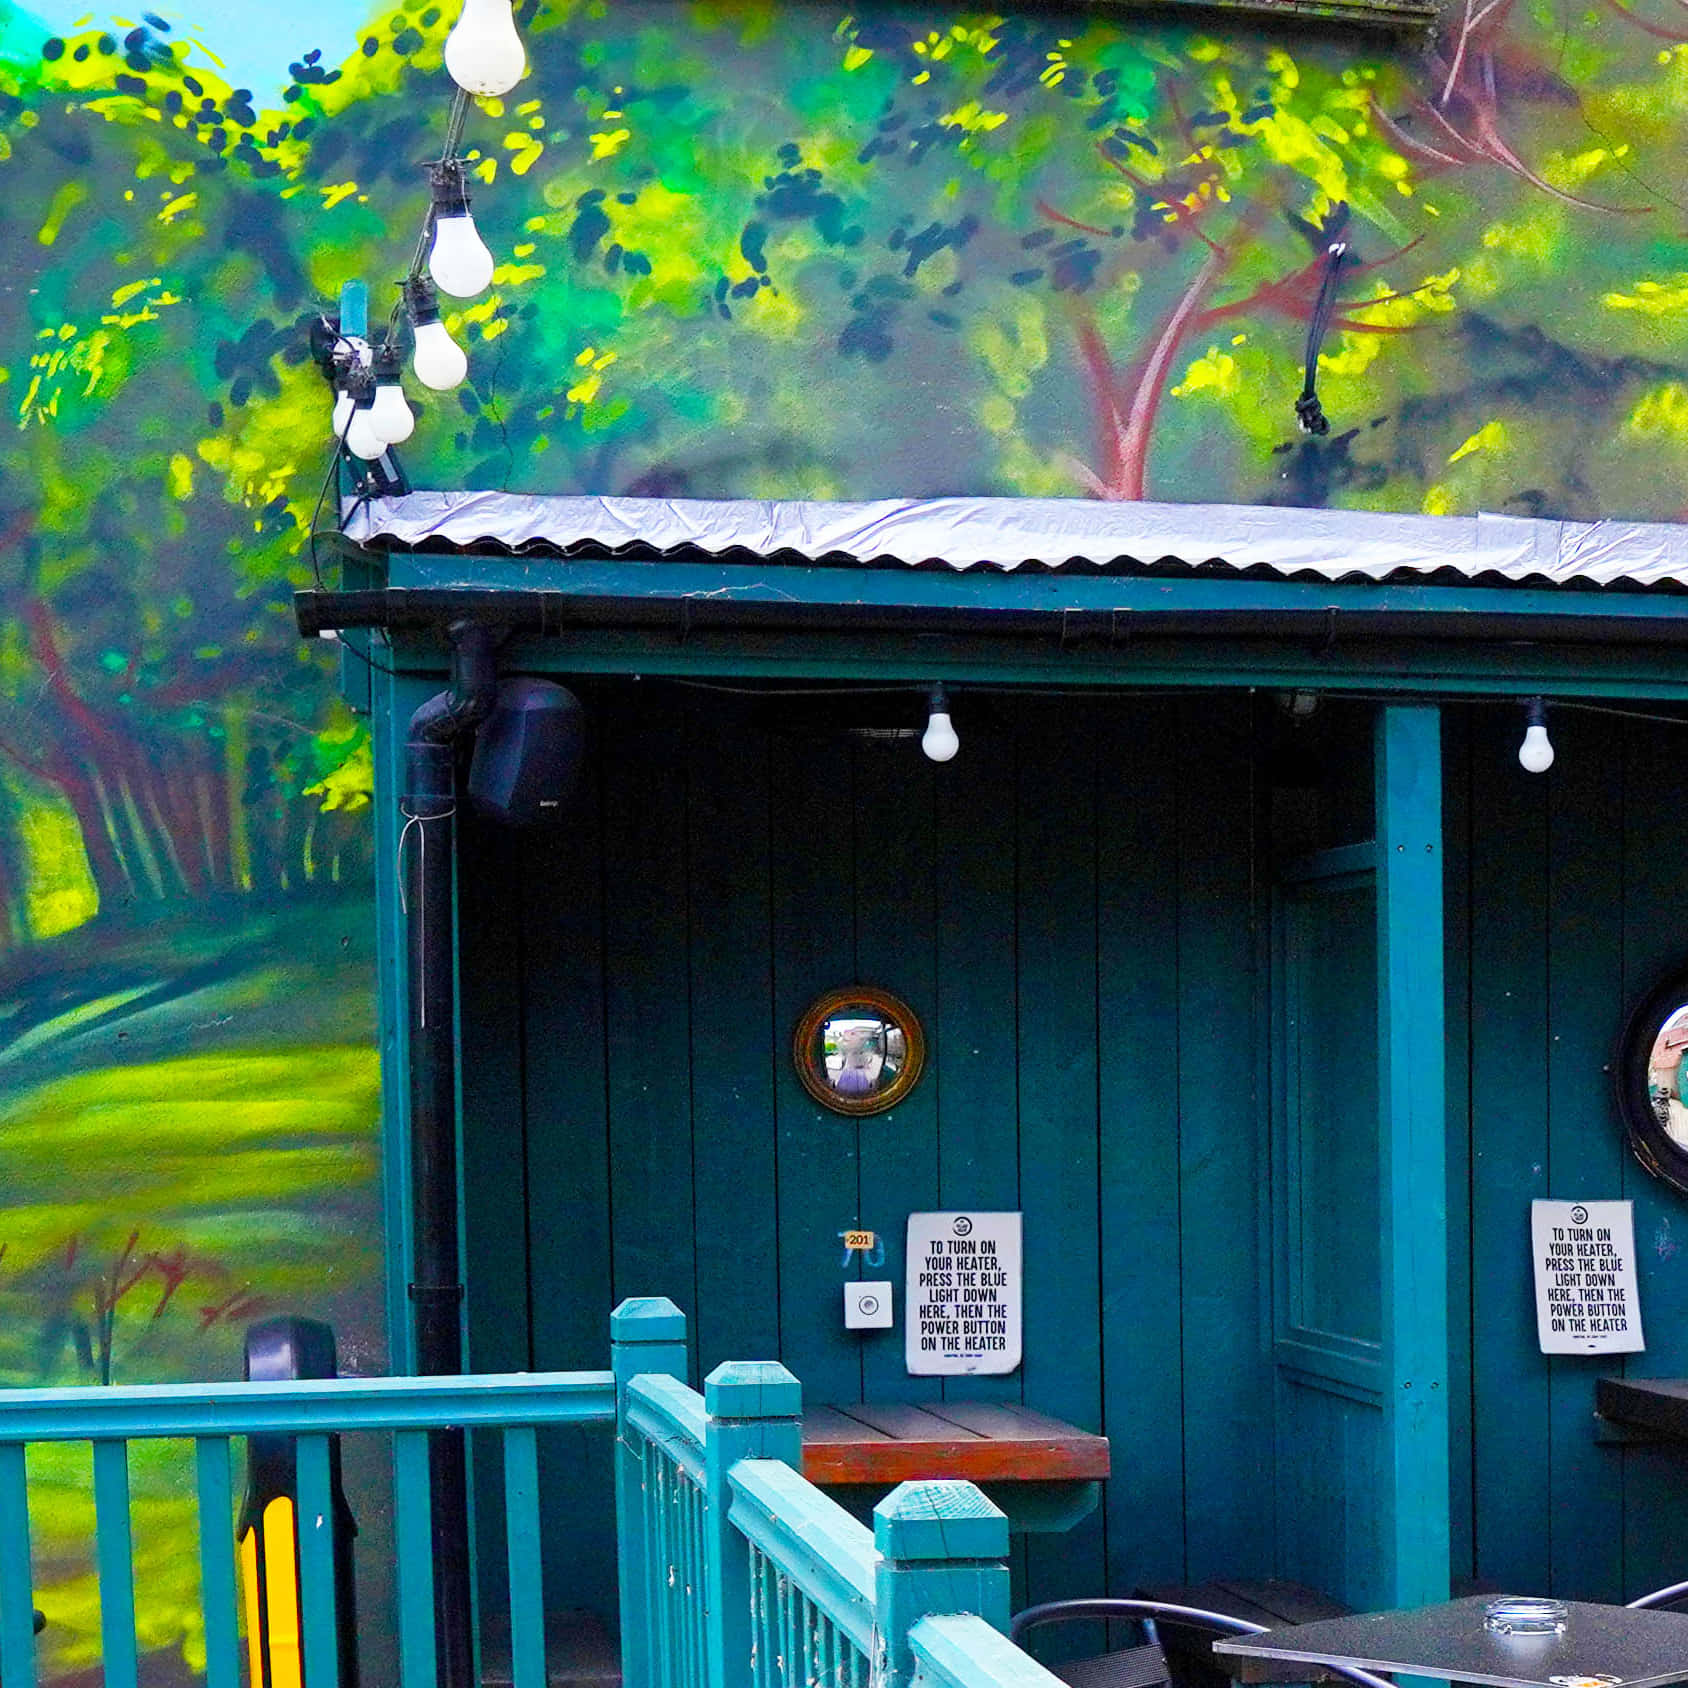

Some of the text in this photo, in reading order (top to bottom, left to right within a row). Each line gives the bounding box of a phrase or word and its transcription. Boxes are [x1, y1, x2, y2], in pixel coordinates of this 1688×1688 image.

[849, 1234, 869, 1246] 201
[1552, 1228, 1610, 1241] TO TURN ON
[930, 1240, 995, 1254] TO TURN ON
[1549, 1243, 1617, 1258] YOUR HEATER,
[925, 1256, 1001, 1272] YOUR HEATER,
[1546, 1258, 1623, 1271] PRESS THE BLUE
[920, 1272, 1007, 1287] PRESS THE BLUE
[1556, 1273, 1615, 1286] LIGHT DOWN
[930, 1288, 996, 1303] LIGHT DOWN
[1548, 1288, 1625, 1302] HERE, THEN THE
[920, 1304, 1007, 1319] HERE, THEN THE
[1551, 1304, 1625, 1317] POWER BUTTON
[921, 1320, 1005, 1335] POWER BUTTON
[1552, 1318, 1627, 1332] ON THE HEATER
[921, 1336, 1005, 1351] ON THE HEATER
